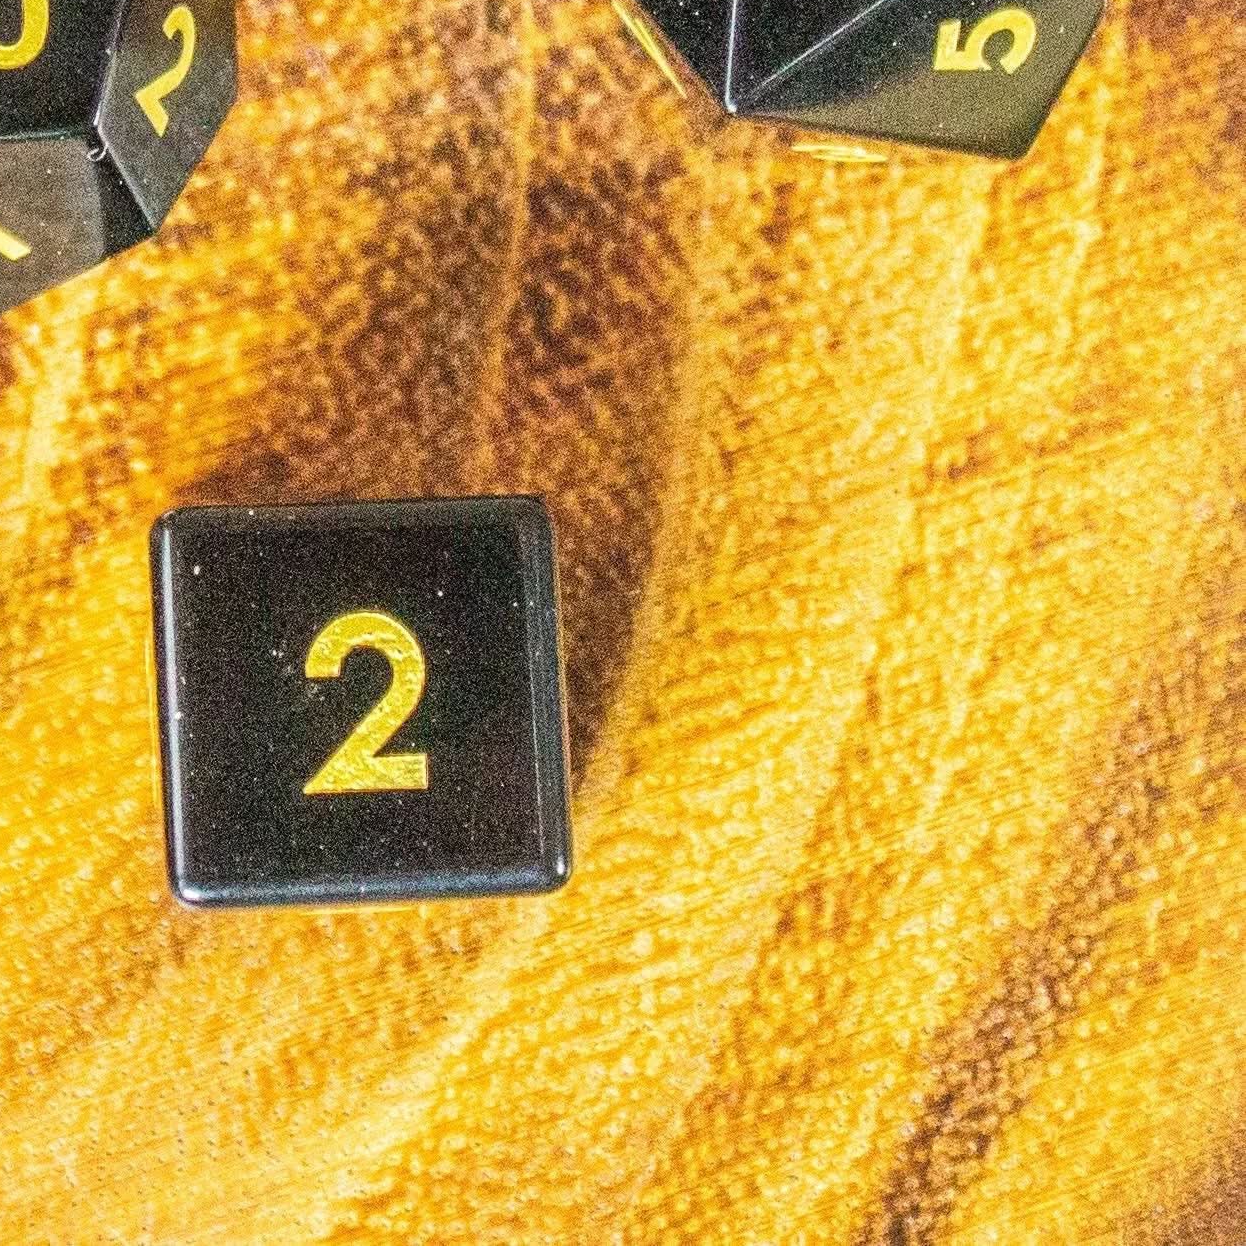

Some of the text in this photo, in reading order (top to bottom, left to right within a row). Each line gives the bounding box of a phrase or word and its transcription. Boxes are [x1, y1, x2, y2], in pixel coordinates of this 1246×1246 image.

[135, 6, 196, 136] 2
[934, 8, 1035, 74] 5
[303, 611, 428, 794] 2
